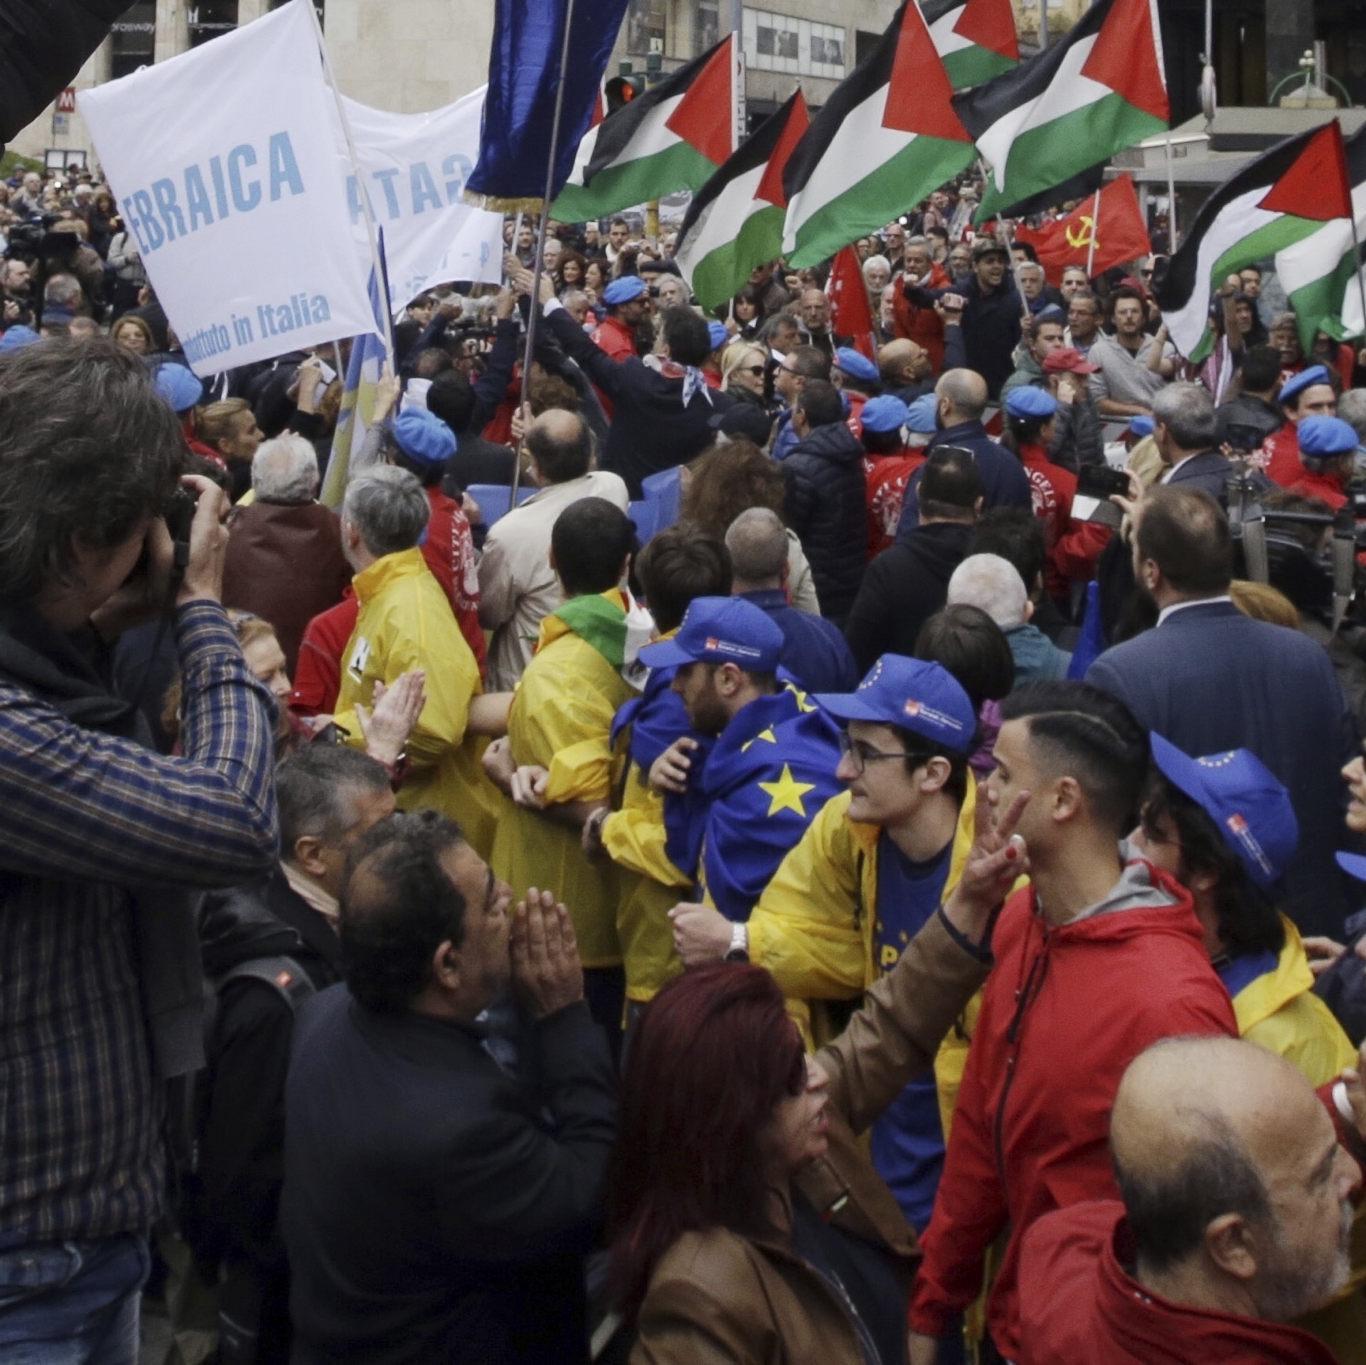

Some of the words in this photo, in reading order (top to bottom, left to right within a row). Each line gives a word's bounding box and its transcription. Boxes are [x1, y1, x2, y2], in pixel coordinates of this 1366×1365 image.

[122, 130, 306, 256] EBRAICA
[231, 312, 255, 347] in
[256, 292, 332, 339] Italia
